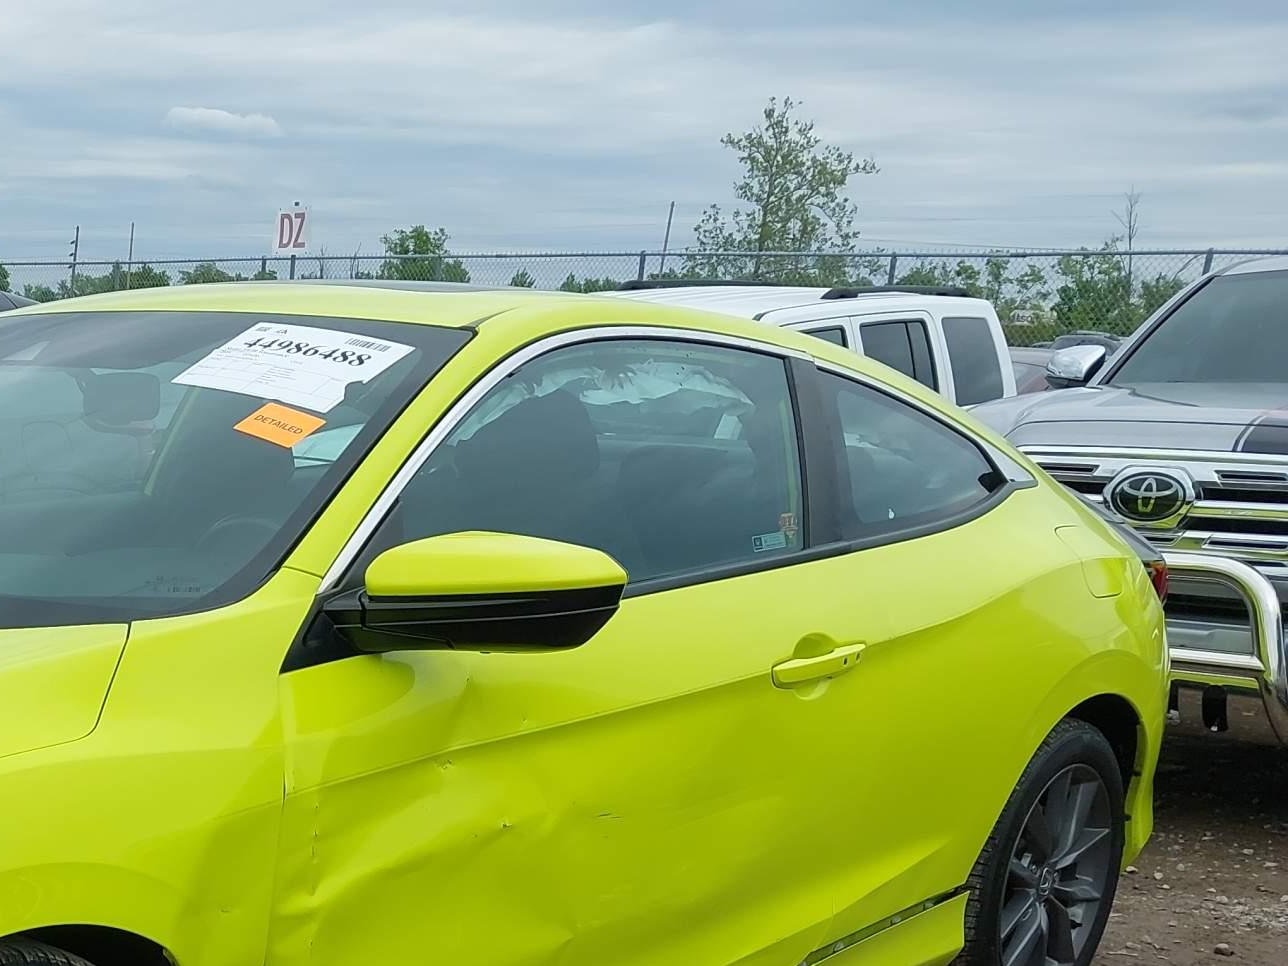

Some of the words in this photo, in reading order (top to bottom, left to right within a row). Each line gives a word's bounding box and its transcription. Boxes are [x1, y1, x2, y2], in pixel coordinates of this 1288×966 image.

[278, 212, 306, 249] DZ
[243, 337, 373, 367] 44986488
[254, 414, 303, 436] DETAILED
